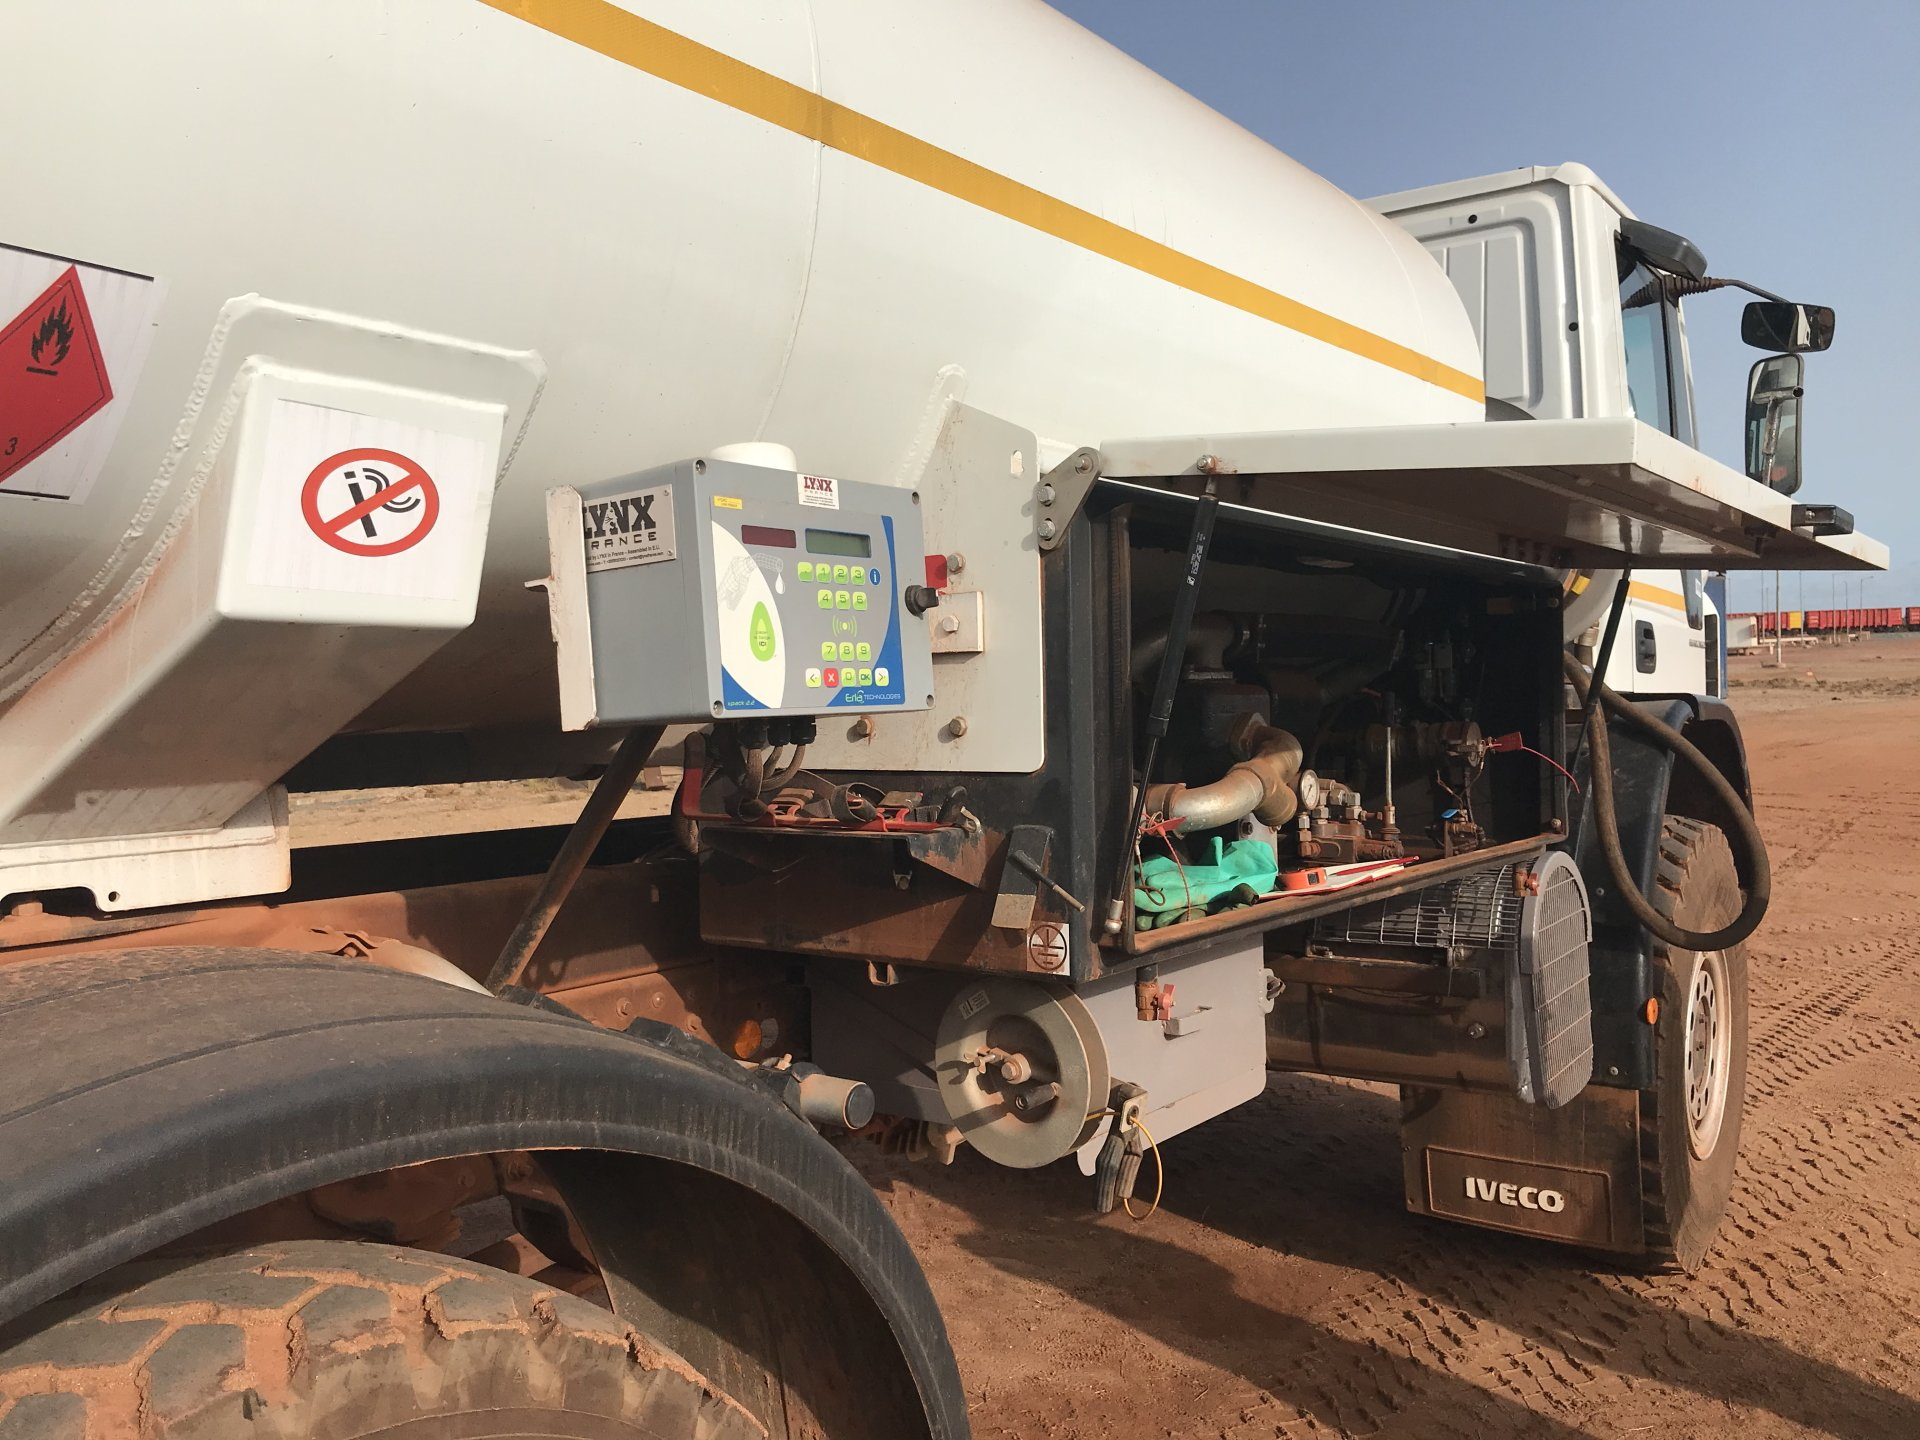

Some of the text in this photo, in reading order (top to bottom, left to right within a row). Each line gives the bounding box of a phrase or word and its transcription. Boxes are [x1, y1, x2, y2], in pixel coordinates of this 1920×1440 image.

[4, 436, 18, 456] 3
[803, 476, 833, 492] LYNX
[590, 531, 657, 551] RANCE
[837, 568, 845, 578] 2
[854, 569, 862, 579] 3
[822, 593, 864, 604] 4 5 6
[843, 645, 851, 655] 8
[860, 646, 867, 655] 9
[860, 673, 870, 681] OK
[1465, 1176, 1565, 1213] IVECO
